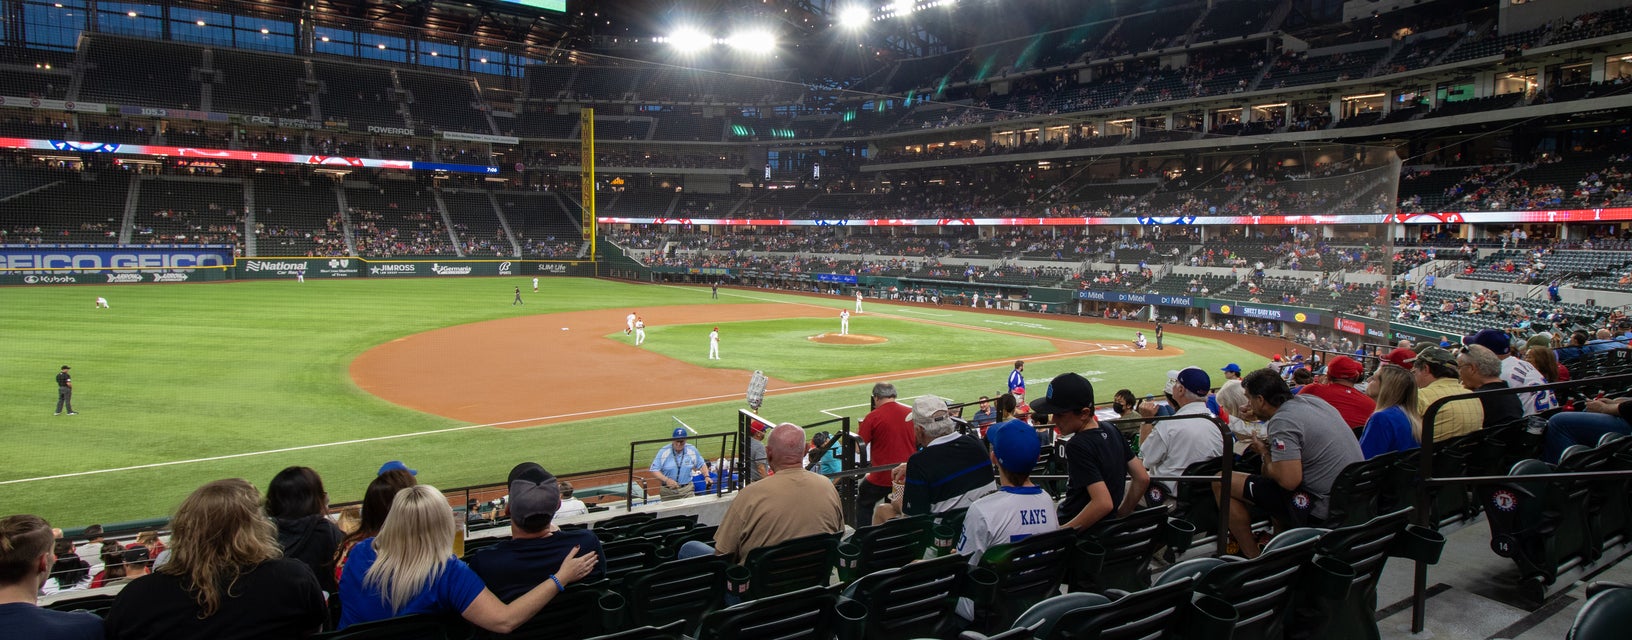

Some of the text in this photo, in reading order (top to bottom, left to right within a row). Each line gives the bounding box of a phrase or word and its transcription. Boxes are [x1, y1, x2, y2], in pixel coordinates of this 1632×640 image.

[141, 108, 166, 116] 105.3
[368, 126, 415, 136] POWERADE
[0, 254, 223, 274] EICO GEICO
[260, 261, 308, 270] National
[41, 275, 76, 283] Kubota
[1087, 292, 1105, 300] Mitel
[1127, 294, 1146, 303] Mitel
[1170, 296, 1190, 306] Mitel
[1617, 350, 1627, 358] 07
[1020, 509, 1047, 525] KAYS
[1499, 543, 1508, 551] 14
